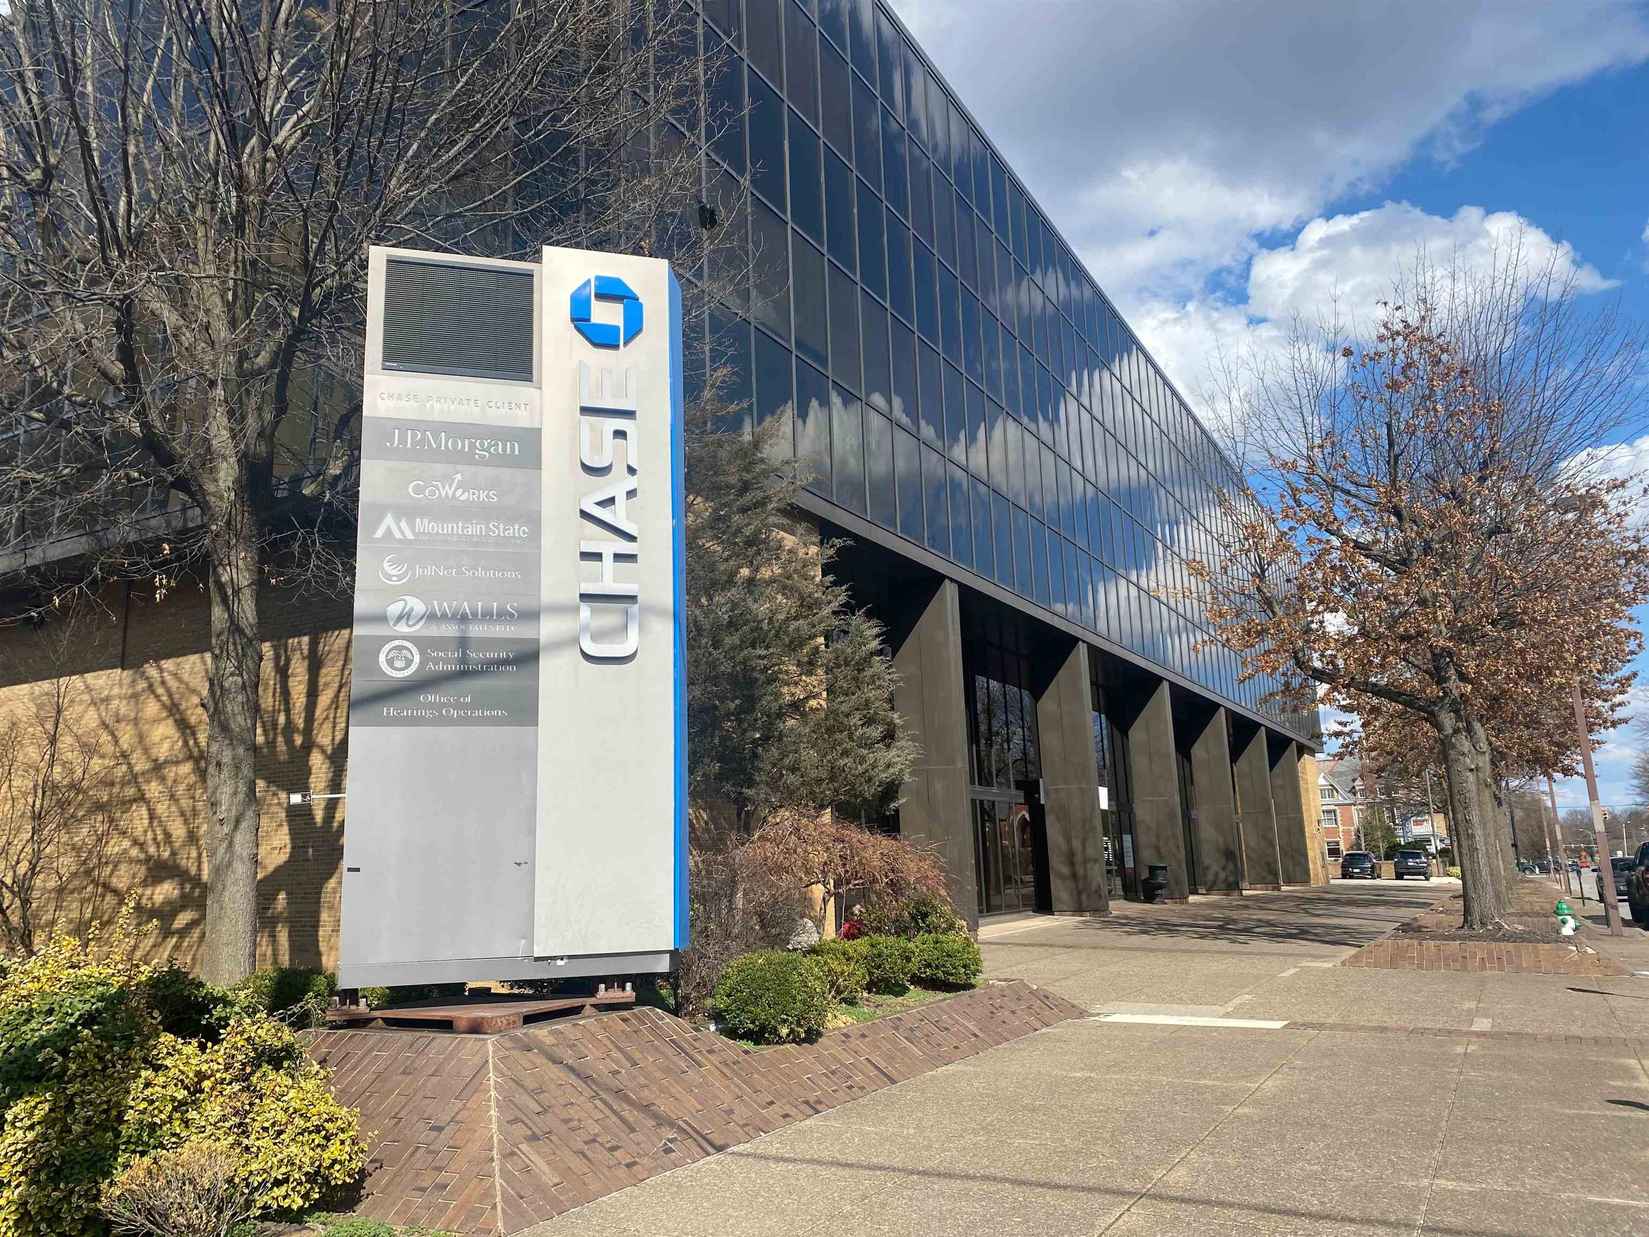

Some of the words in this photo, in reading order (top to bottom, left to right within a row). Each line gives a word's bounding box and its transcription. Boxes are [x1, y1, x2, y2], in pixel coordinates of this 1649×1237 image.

[378, 391, 420, 404] CHASE
[425, 394, 481, 408] PRIVATE
[486, 400, 529, 412] CLIENT
[578, 360, 639, 666] CHASE
[415, 518, 485, 536] Mountain
[488, 521, 529, 538] State
[462, 566, 521, 579] Solutions
[432, 600, 519, 621] WALLS
[426, 648, 462, 659] Social
[466, 649, 514, 660] Security
[425, 661, 518, 673] Administration
[420, 693, 457, 704] Office
[461, 694, 472, 704] of
[383, 706, 439, 719] Hearings
[442, 707, 508, 719] Operations
